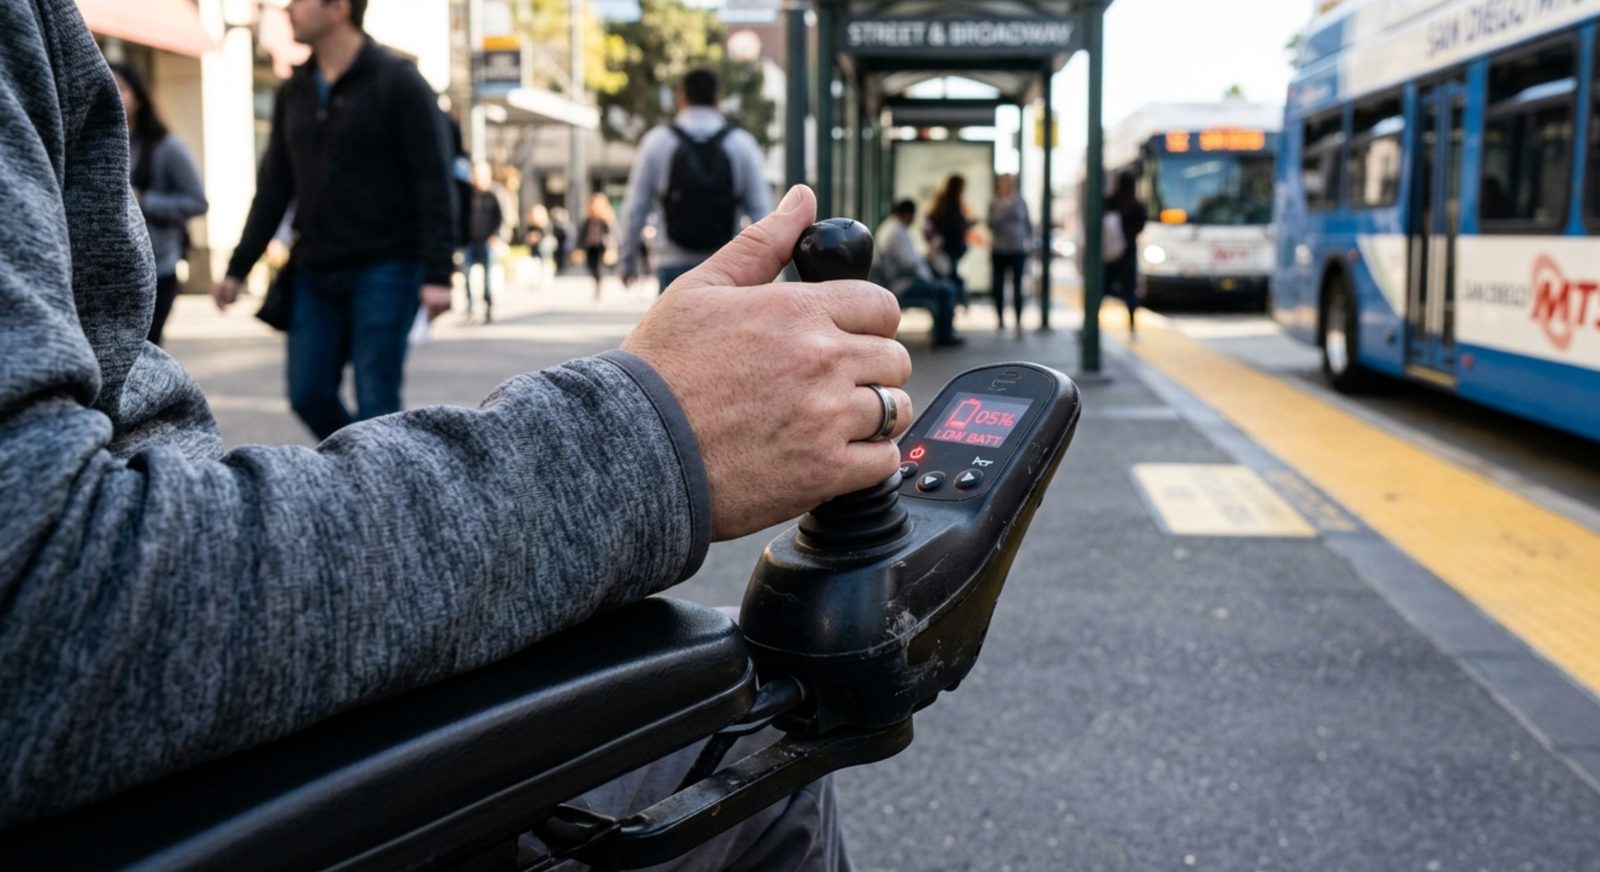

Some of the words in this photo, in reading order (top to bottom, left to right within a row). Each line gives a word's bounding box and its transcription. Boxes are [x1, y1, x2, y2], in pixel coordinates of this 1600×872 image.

[847, 20, 925, 47] STREET
[927, 20, 947, 46] &
[949, 20, 1074, 46] BROADWAY
[1427, 17, 1459, 56] SAN
[1531, 279, 1600, 332] MT
[932, 430, 966, 442] LOW
[966, 432, 1003, 447] BATT
